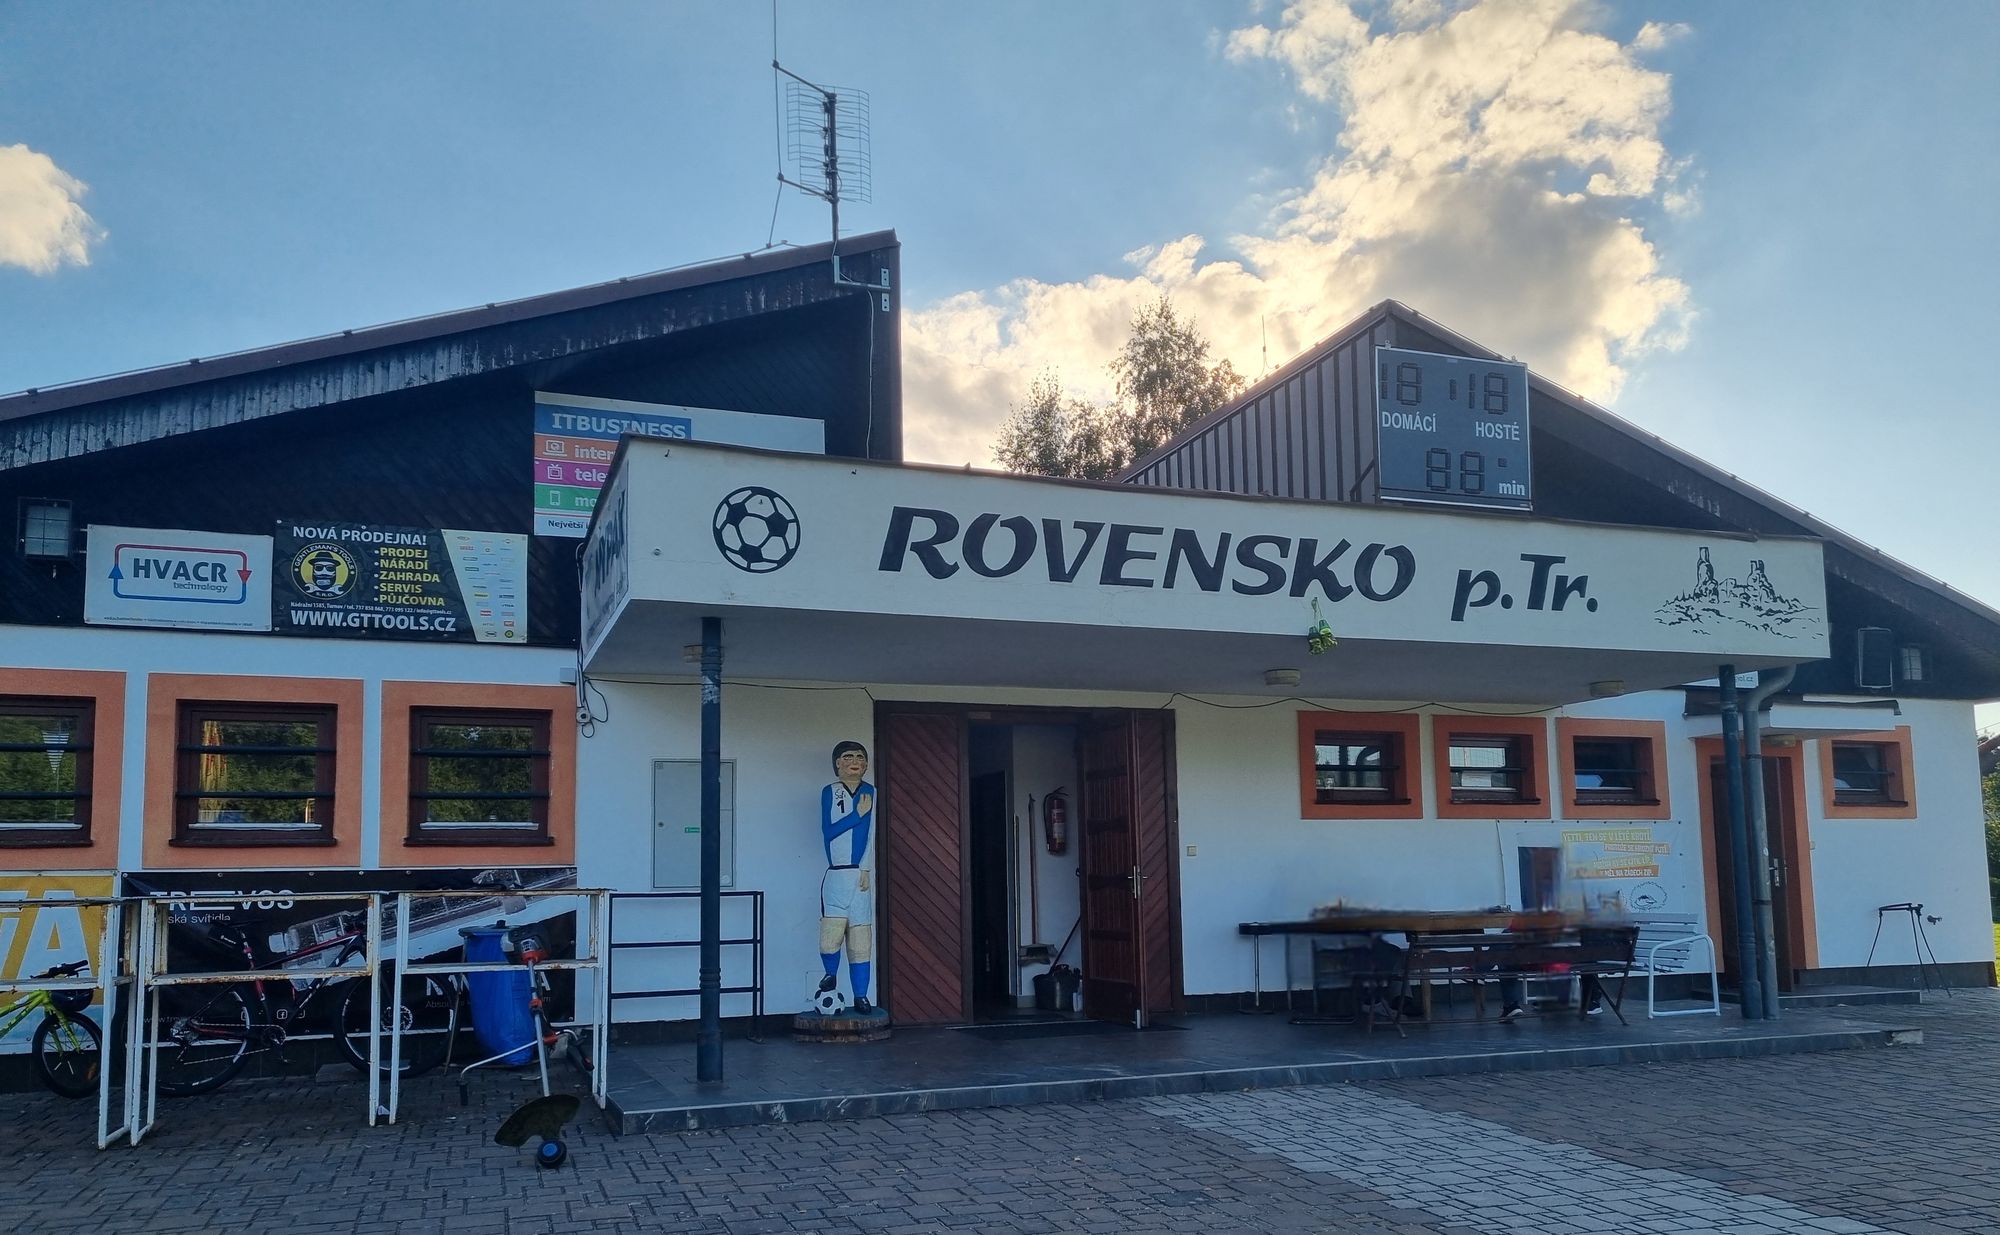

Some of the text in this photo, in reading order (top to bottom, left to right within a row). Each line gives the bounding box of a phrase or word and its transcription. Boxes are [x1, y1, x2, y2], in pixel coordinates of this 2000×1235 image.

[551, 412, 686, 439] ITBUSINESS
[1382, 411, 1436, 432] DOMÁCÍ
[1475, 421, 1520, 441] HOSTÉ
[574, 445, 615, 460] inter
[574, 467, 608, 482] tele
[1498, 480, 1526, 496] min
[548, 519, 584, 530] Největší
[292, 525, 427, 546] NOVÁ PRODEJNA!
[295, 545, 355, 570] GENTLEMAN'S TOOLS
[379, 546, 428, 558] PRODEJ
[132, 557, 228, 583] HVACR
[379, 557, 429, 570] NÁŘADÍ
[877, 505, 1599, 623] ROVENSKO p.Tr.
[379, 571, 440, 583] ZAHRADA
[173, 581, 228, 593] technology
[379, 583, 423, 593] SERVIS
[379, 593, 445, 606] PŮJČOVNA
[290, 609, 456, 632] WWW.GTTOOLS.CZ
[836, 799, 845, 814] 1
